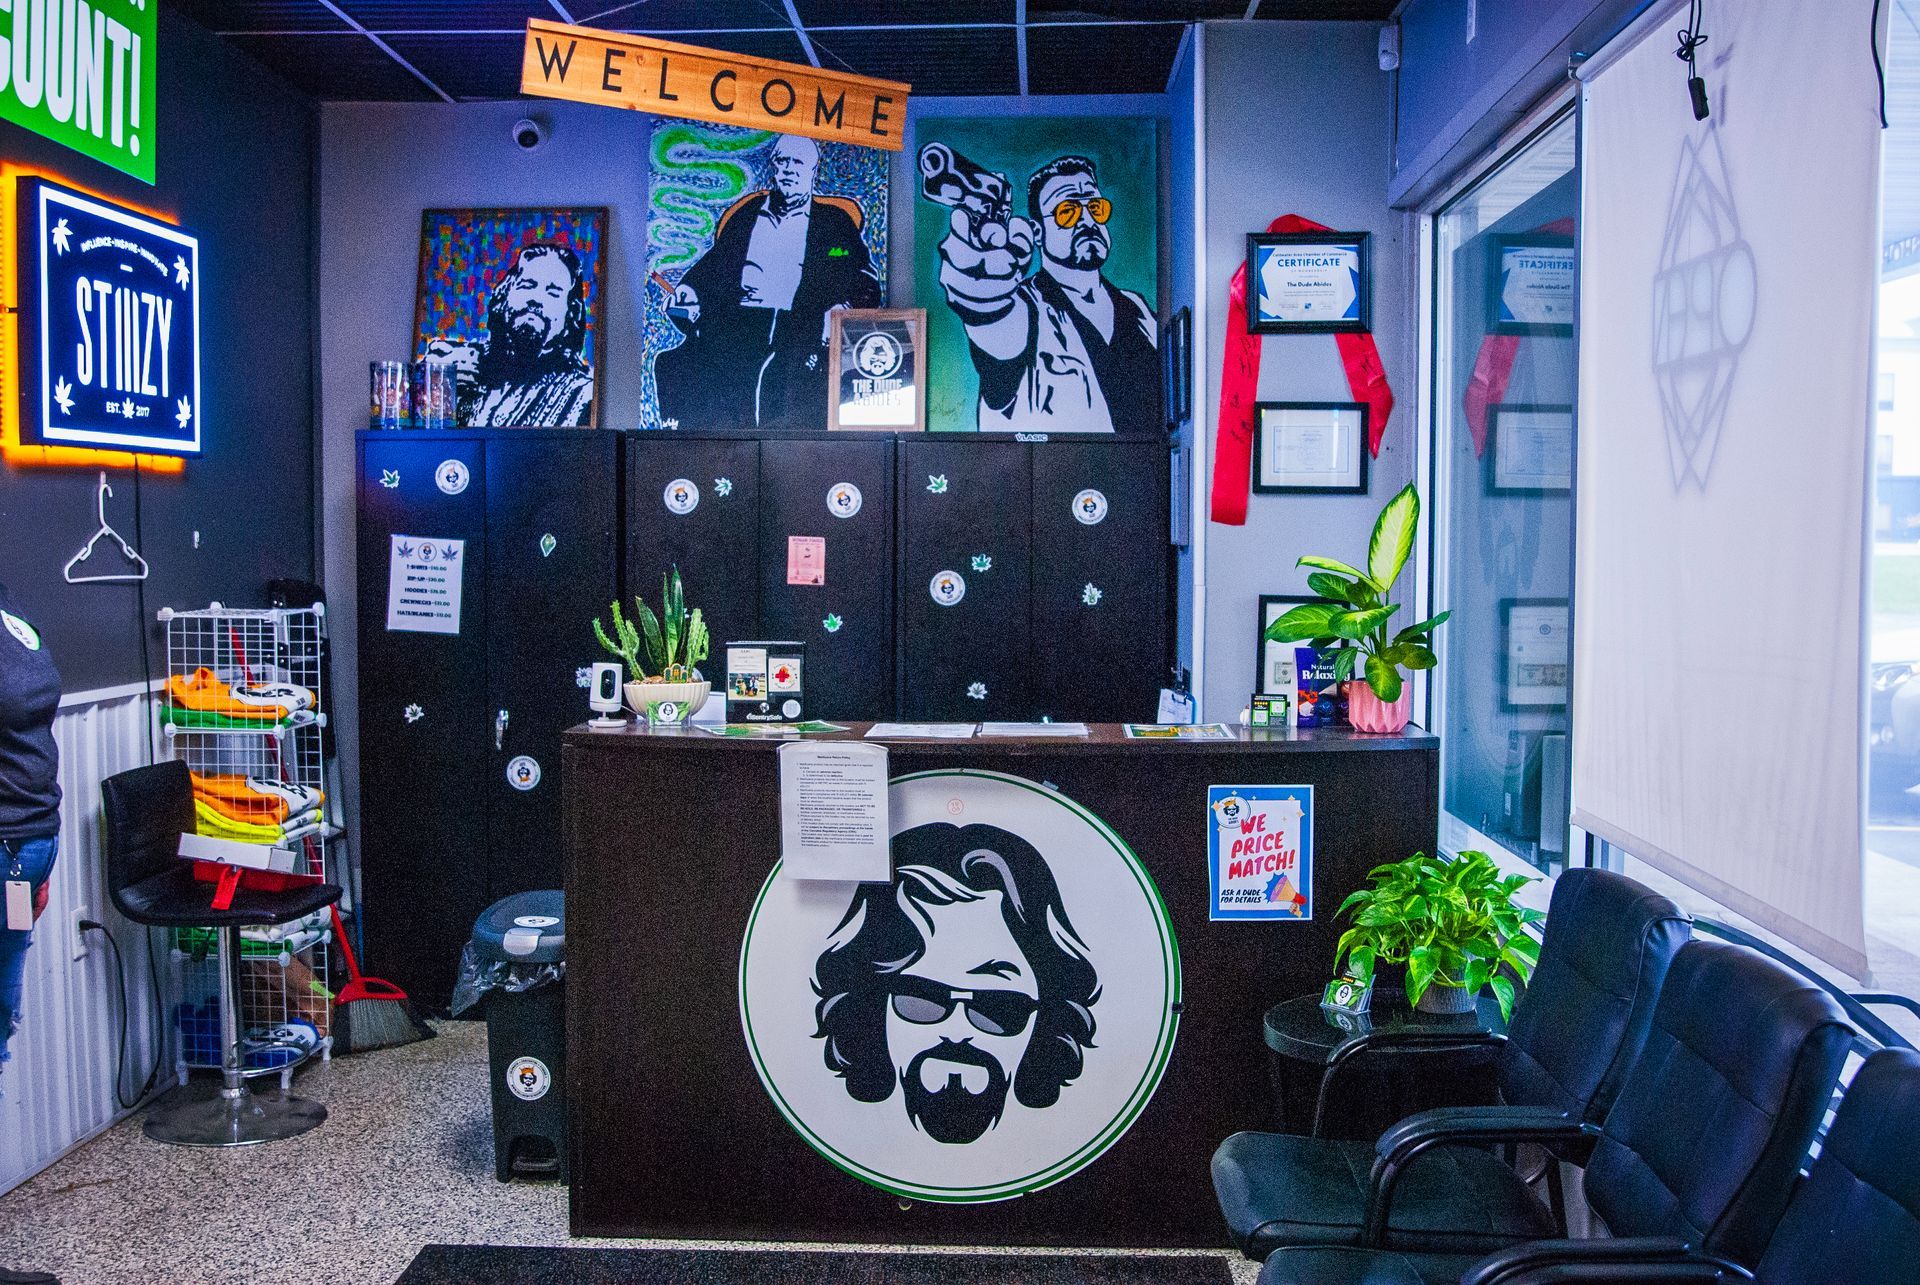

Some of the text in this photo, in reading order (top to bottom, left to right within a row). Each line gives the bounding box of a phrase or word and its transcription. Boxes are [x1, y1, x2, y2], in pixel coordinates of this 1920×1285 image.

[535, 37, 893, 136] WELCOME
[1277, 258, 1340, 267] CERTIFICATE
[76, 276, 173, 397] STIIIZY
[852, 378, 902, 393] THE DUDE
[105, 401, 150, 418] EST. 2017
[1302, 670, 1351, 682] Rlaxig
[1240, 813, 1267, 835] WE
[1231, 831, 1284, 859] PRICE
[1228, 849, 1296, 880] MATCH!
[1221, 888, 1235, 896] ASK
[1242, 888, 1261, 896] DUDE
